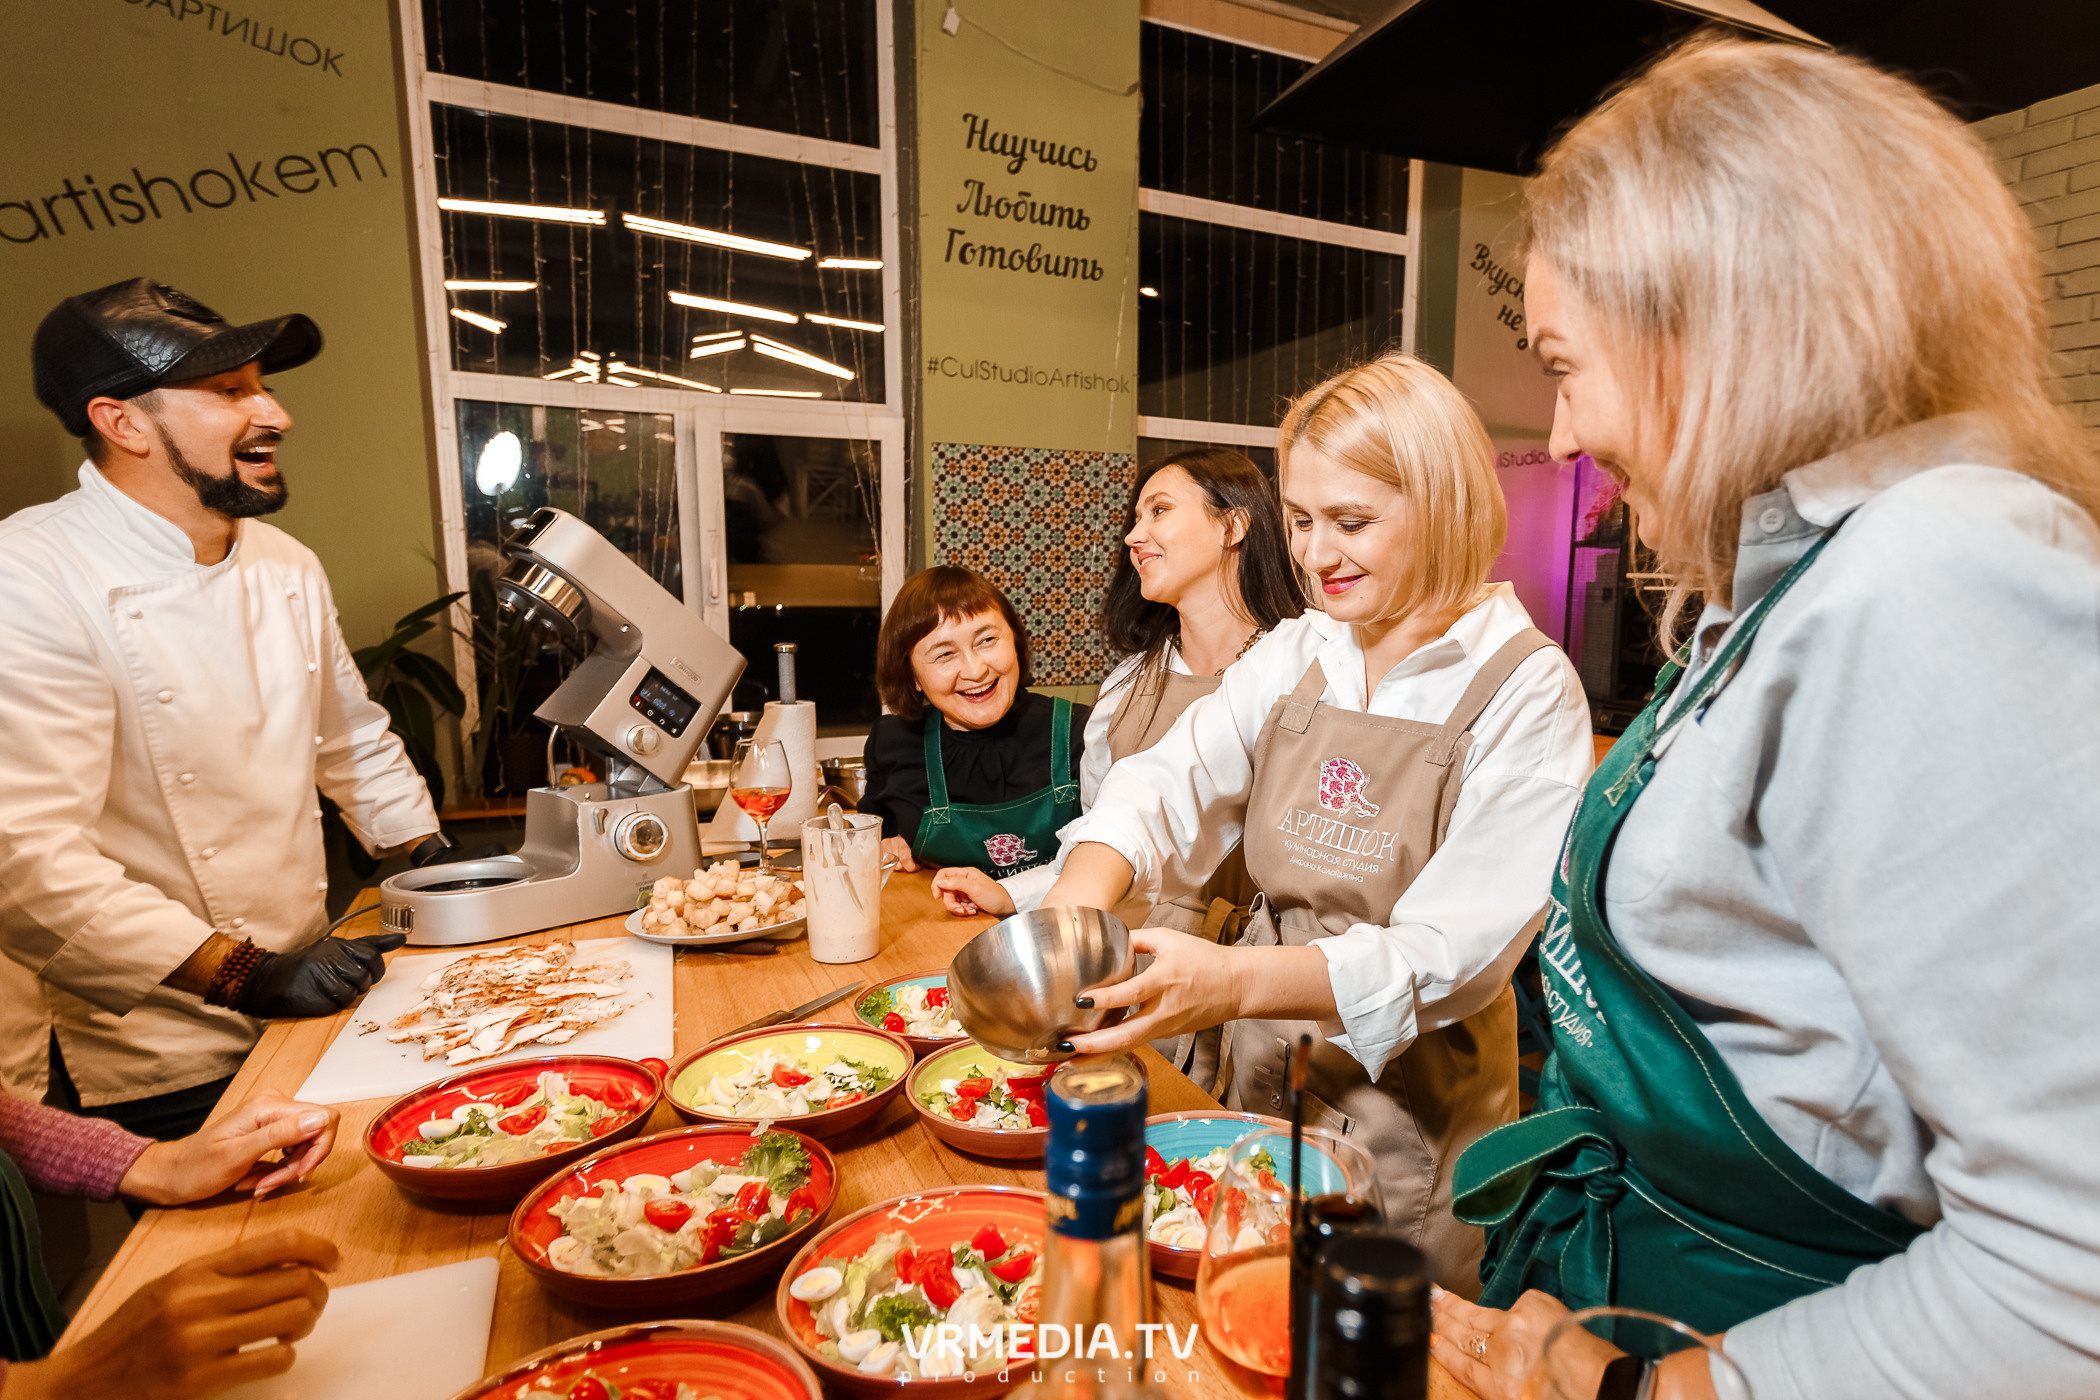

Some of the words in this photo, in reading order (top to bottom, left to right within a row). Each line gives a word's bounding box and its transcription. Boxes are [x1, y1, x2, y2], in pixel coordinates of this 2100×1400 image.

[123, 0, 344, 77] АРТИШОК
[962, 112, 1098, 175] Научись
[956, 178, 1091, 231] Любить
[944, 228, 1104, 281] Готовить
[1470, 242, 1525, 303] Вкусн
[927, 355, 1130, 394] #CulStudioArtishok
[1276, 807, 1399, 861] АРТИШОК
